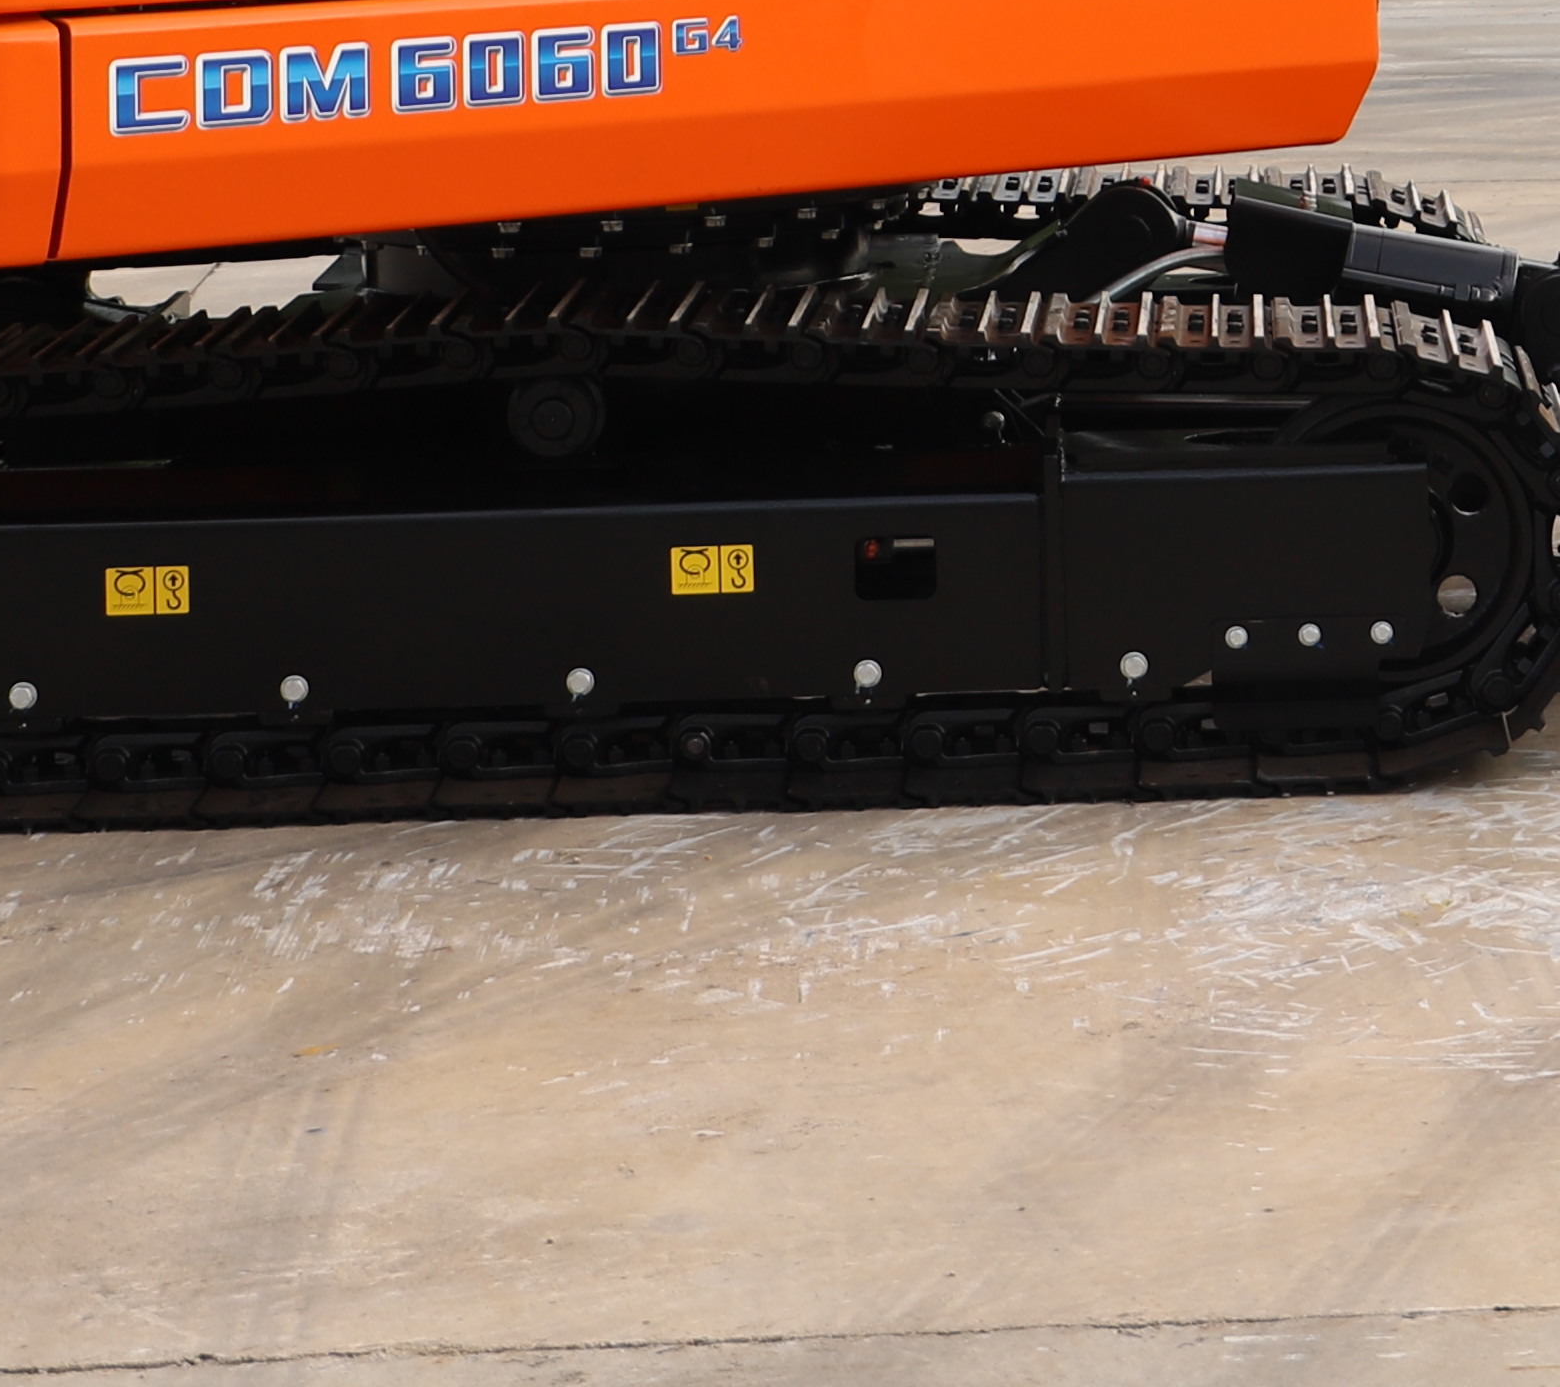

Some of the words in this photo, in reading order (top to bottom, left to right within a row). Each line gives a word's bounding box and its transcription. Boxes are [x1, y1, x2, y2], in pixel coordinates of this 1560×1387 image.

[108, 41, 372, 138] CDM
[390, 20, 663, 114] 6060
[671, 14, 743, 57] G4
